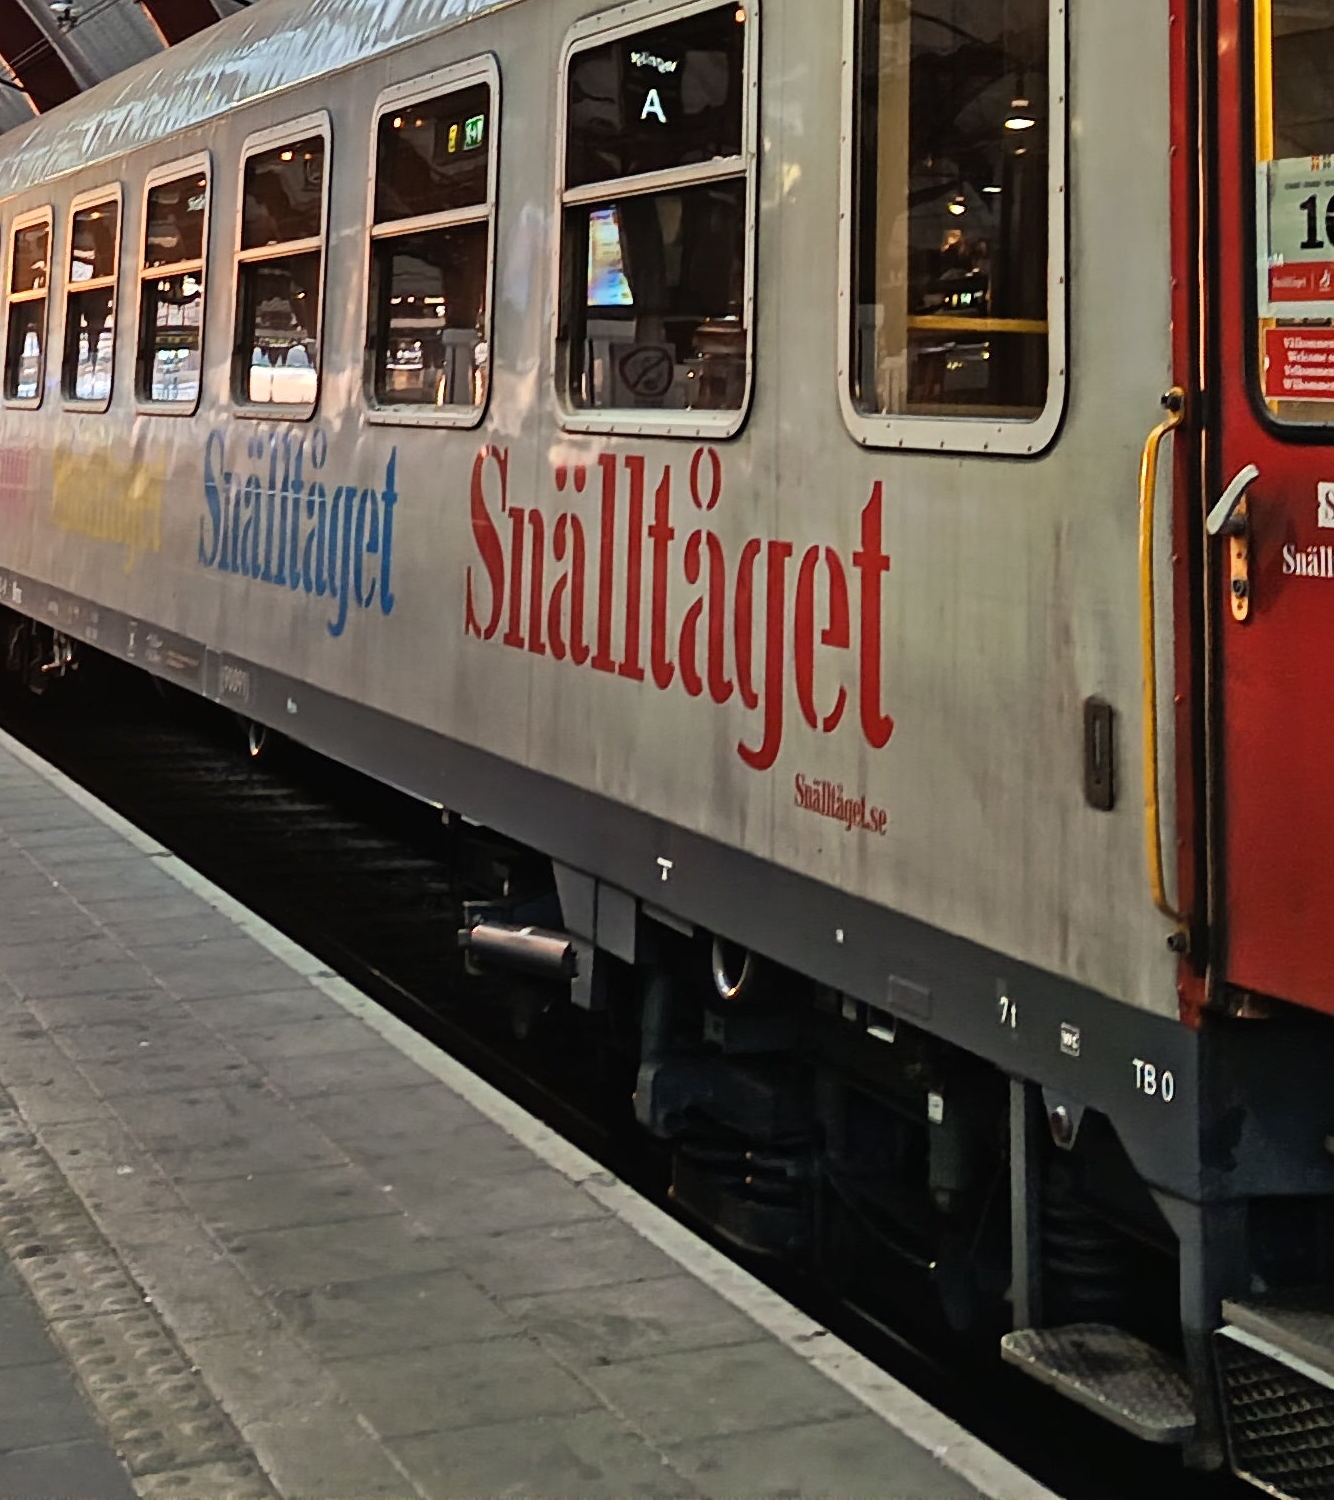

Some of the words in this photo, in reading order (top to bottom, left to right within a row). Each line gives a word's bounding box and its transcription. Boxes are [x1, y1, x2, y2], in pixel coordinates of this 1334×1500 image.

[199, 427, 399, 638] Snälltåget
[464, 444, 895, 771] Snälltåget
[794, 772, 889, 837] Snälltåget.se
[1131, 1057, 1158, 1096] TB
